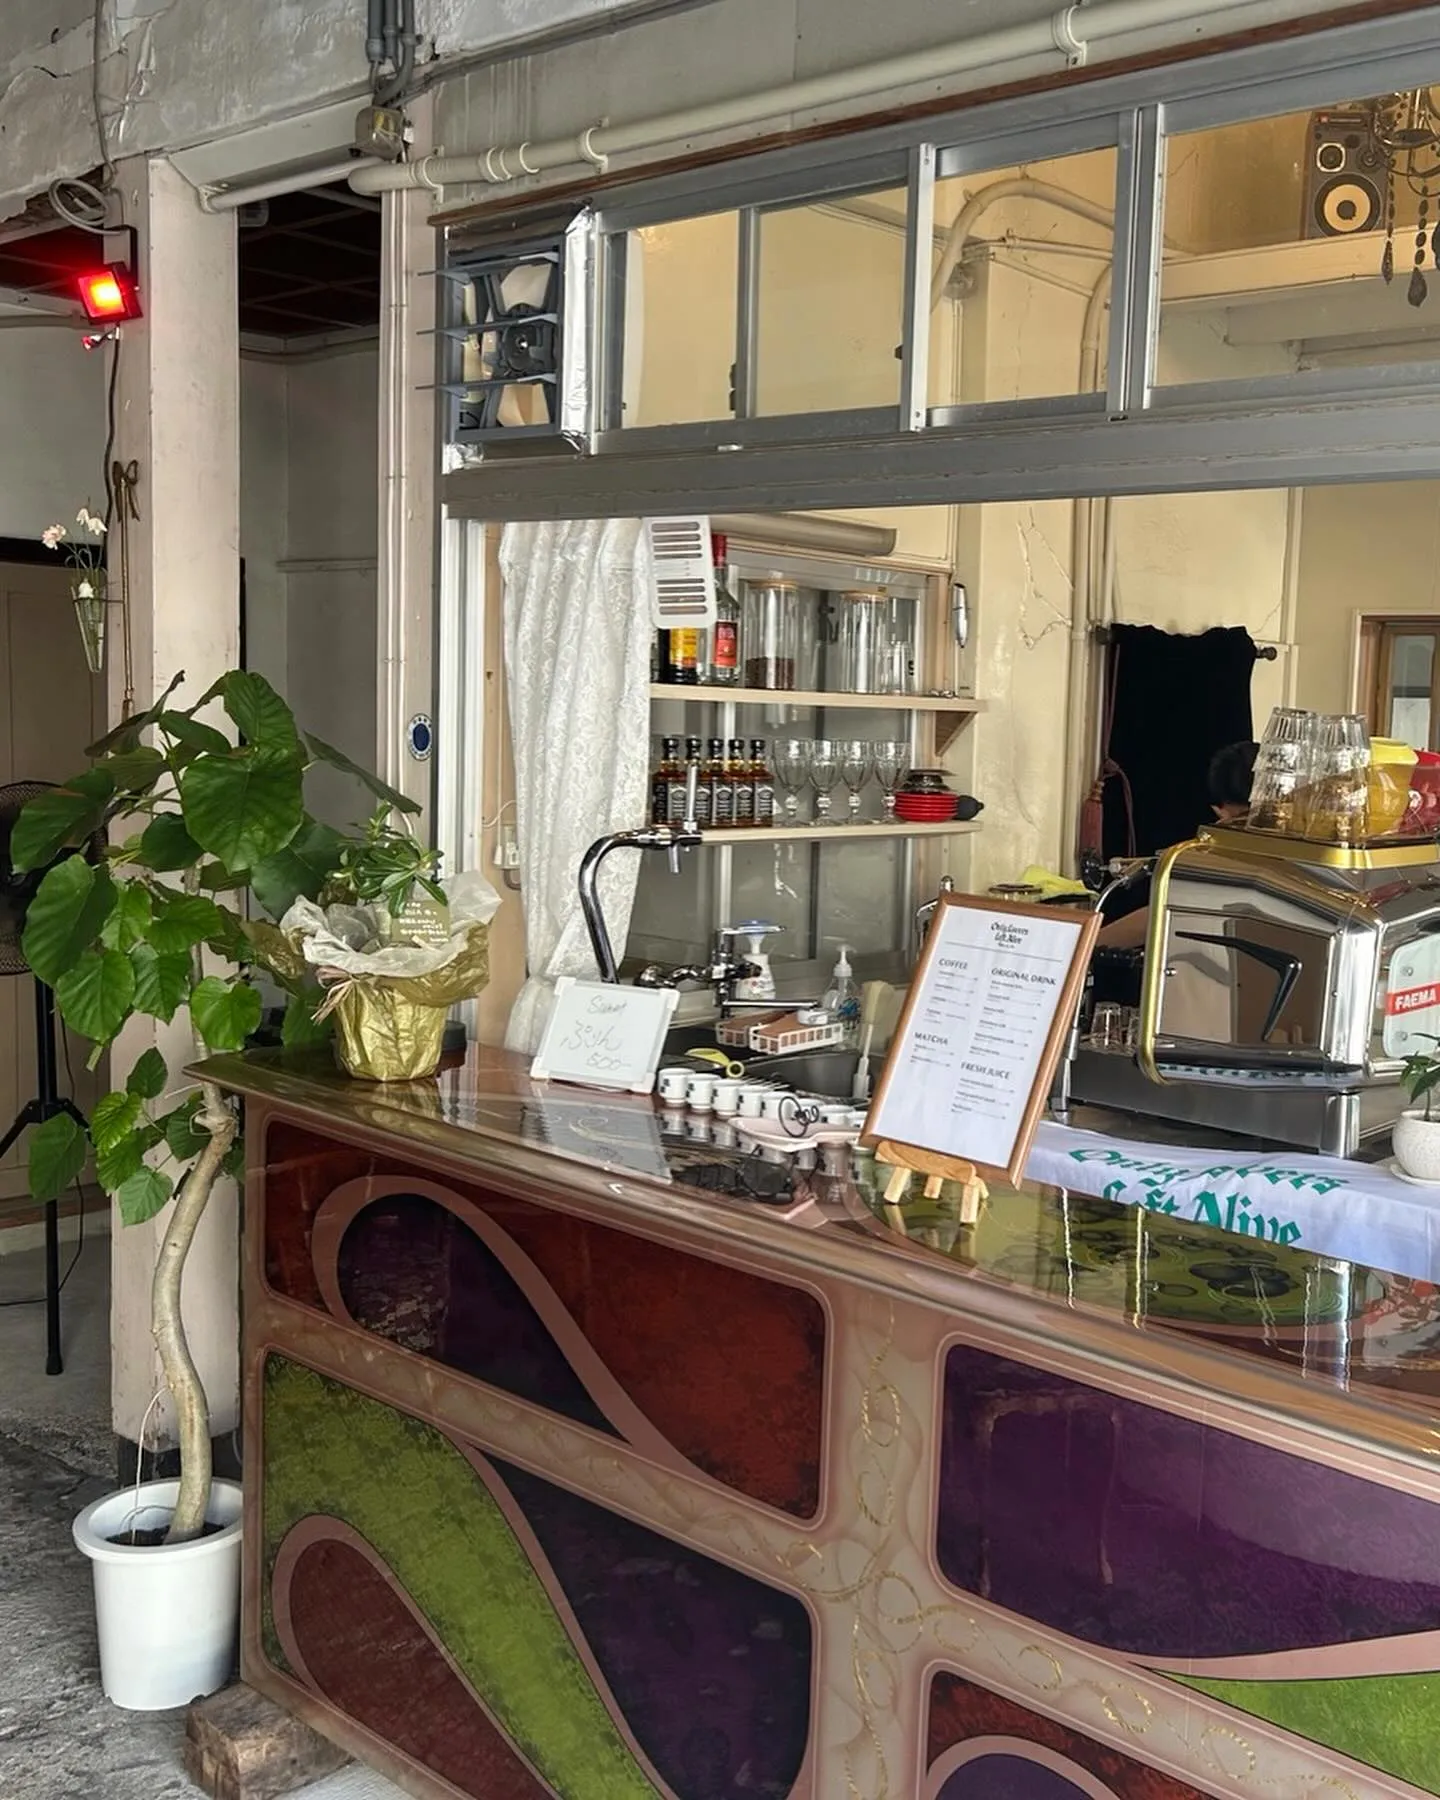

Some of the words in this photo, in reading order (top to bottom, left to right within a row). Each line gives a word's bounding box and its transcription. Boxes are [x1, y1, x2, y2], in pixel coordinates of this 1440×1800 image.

[938, 958, 968, 970] COFFEE
[991, 967, 1028, 981] ORIGINAL
[1031, 974, 1057, 986] DRINK
[1395, 988, 1437, 1011] FAEMA
[914, 1032, 949, 1046] MATCHA
[961, 1061, 986, 1075] FRESH
[986, 1066, 1011, 1080] JUICE
[1068, 1148, 1190, 1188] Only
[1193, 1190, 1302, 1247] Alive
